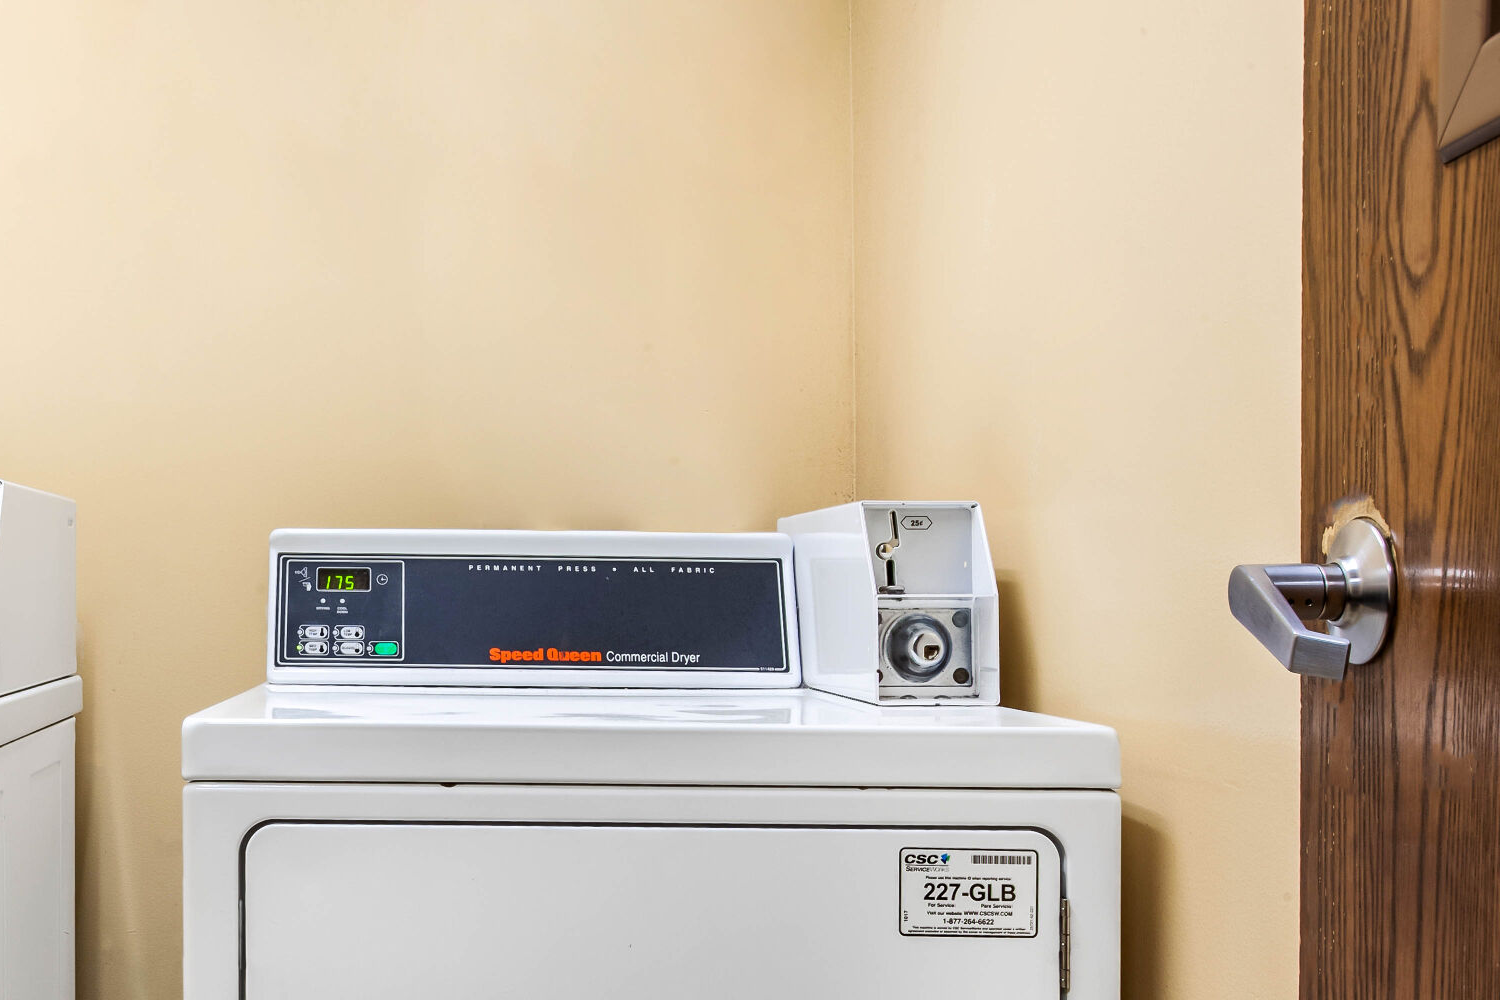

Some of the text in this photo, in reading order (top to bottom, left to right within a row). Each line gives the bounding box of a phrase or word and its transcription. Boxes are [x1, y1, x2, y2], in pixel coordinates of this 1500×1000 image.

[468, 564, 542, 572] PERMANENT
[557, 565, 597, 573] PRESS
[670, 566, 716, 574] FABRIC
[325, 575, 355, 590] 175
[489, 647, 701, 666] Speed Queen Commercial Dryer
[904, 854, 939, 865] CSC
[923, 882, 1016, 902] 227-GLB
[942, 918, 995, 926] 1-877-264-6622
